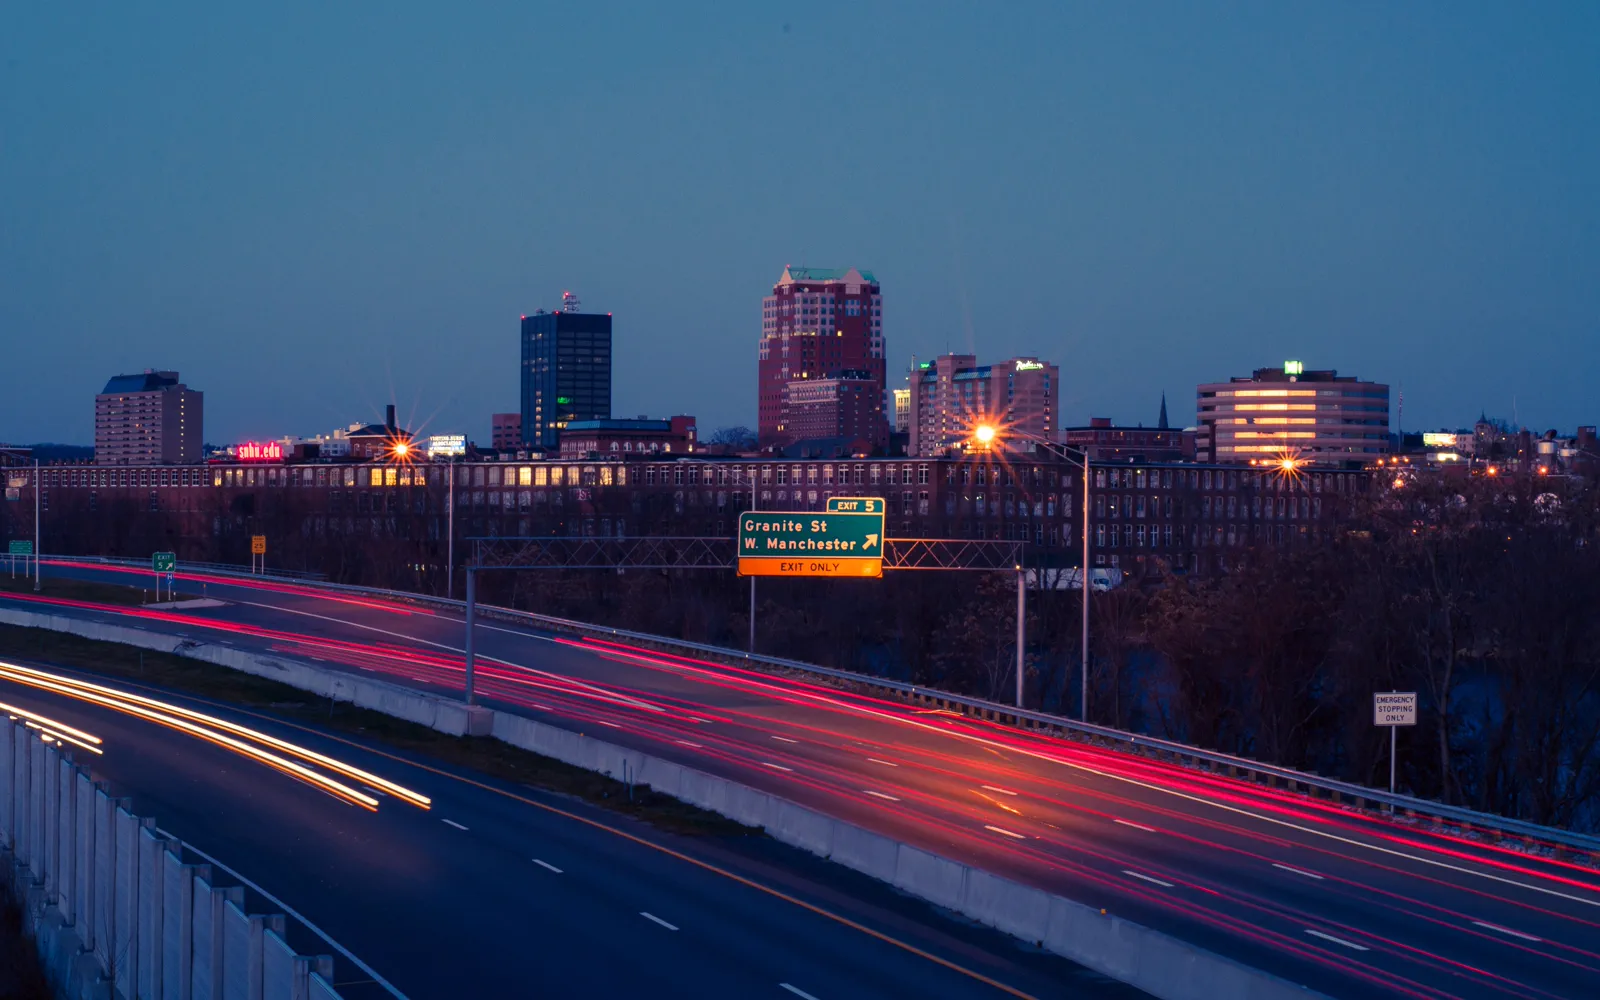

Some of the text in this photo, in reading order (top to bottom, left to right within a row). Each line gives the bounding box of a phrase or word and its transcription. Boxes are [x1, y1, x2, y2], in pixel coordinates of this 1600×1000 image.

[837, 501, 875, 512] EXIT 5
[745, 519, 828, 532] Granite St
[744, 537, 857, 551] W. Manchester
[780, 562, 840, 572] EXIT ONLY
[1376, 696, 1414, 704] EMERGENCY
[1378, 705, 1413, 713] STOPPING
